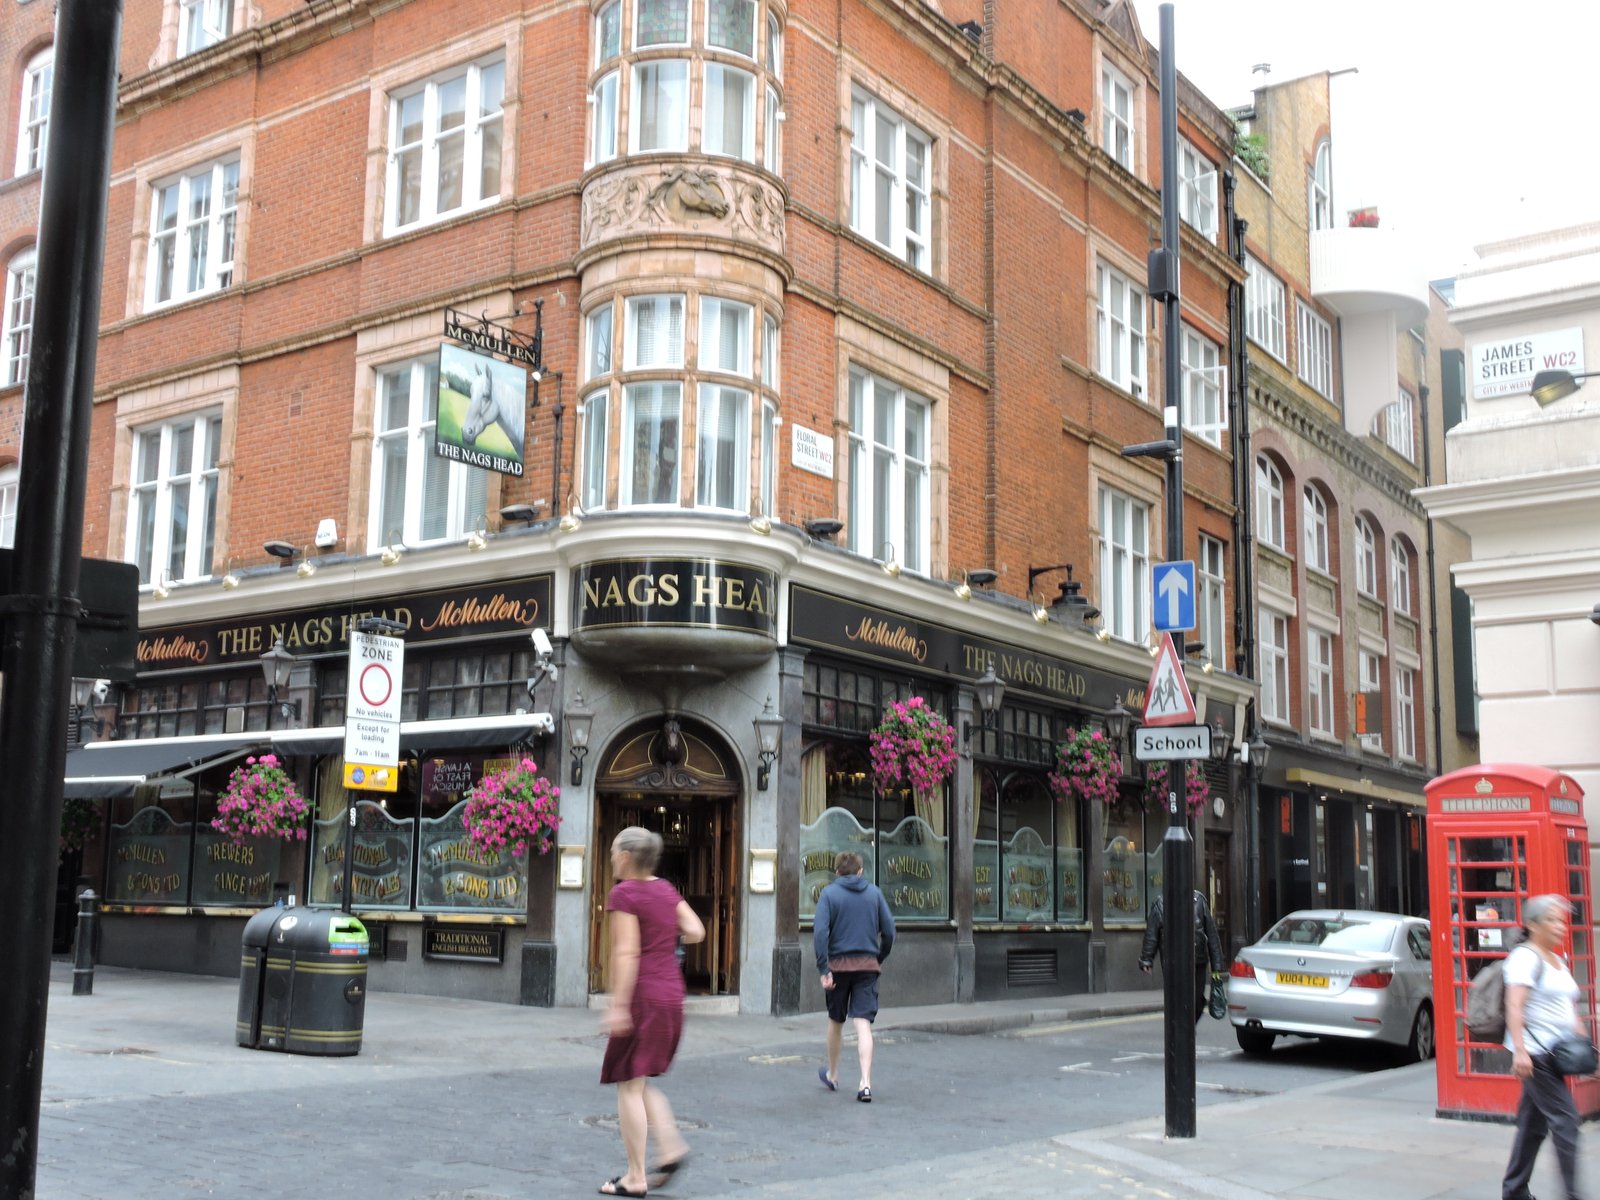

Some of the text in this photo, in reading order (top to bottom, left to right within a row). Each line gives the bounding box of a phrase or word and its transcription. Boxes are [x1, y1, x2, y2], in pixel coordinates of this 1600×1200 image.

[447, 324, 537, 364] McMULLEN
[1481, 341, 1533, 362] JAMES
[1482, 351, 1577, 379] STREET WC2
[796, 429, 817, 447] FLORAL
[437, 442, 523, 475] THE NAGS HEAD
[796, 442, 832, 464] STREET WC2
[582, 574, 777, 619] NAGS HEAD
[137, 635, 209, 664] McMullen
[217, 627, 255, 656] THE
[269, 616, 334, 652] NAGS
[420, 593, 539, 632] McMullen
[356, 634, 400, 649] PEDESTRIAN
[361, 646, 393, 662] ZONE
[845, 616, 928, 663] McMullen
[963, 644, 996, 673] THE
[1002, 654, 1043, 687] NAGS
[1046, 666, 1086, 697] HEAD
[356, 707, 393, 719] No vehicles
[357, 723, 379, 734] Except
[361, 732, 385, 743] loading
[355, 748, 369, 758] 7am
[375, 749, 390, 759] 11am
[1143, 735, 1202, 752] School
[1445, 797, 1527, 811] TELEPHONE
[322, 843, 387, 864] TRATIONAL
[431, 841, 500, 866] McMULLN
[888, 855, 932, 880] McMULLEN
[333, 873, 377, 896] CONTRY
[456, 873, 489, 899] SONS
[493, 875, 518, 900] LTD
[431, 943, 493, 955] ENGLISH BREAKFAST
[435, 932, 490, 945] TRADITIONAL
[1305, 975, 1326, 986] TCJ
